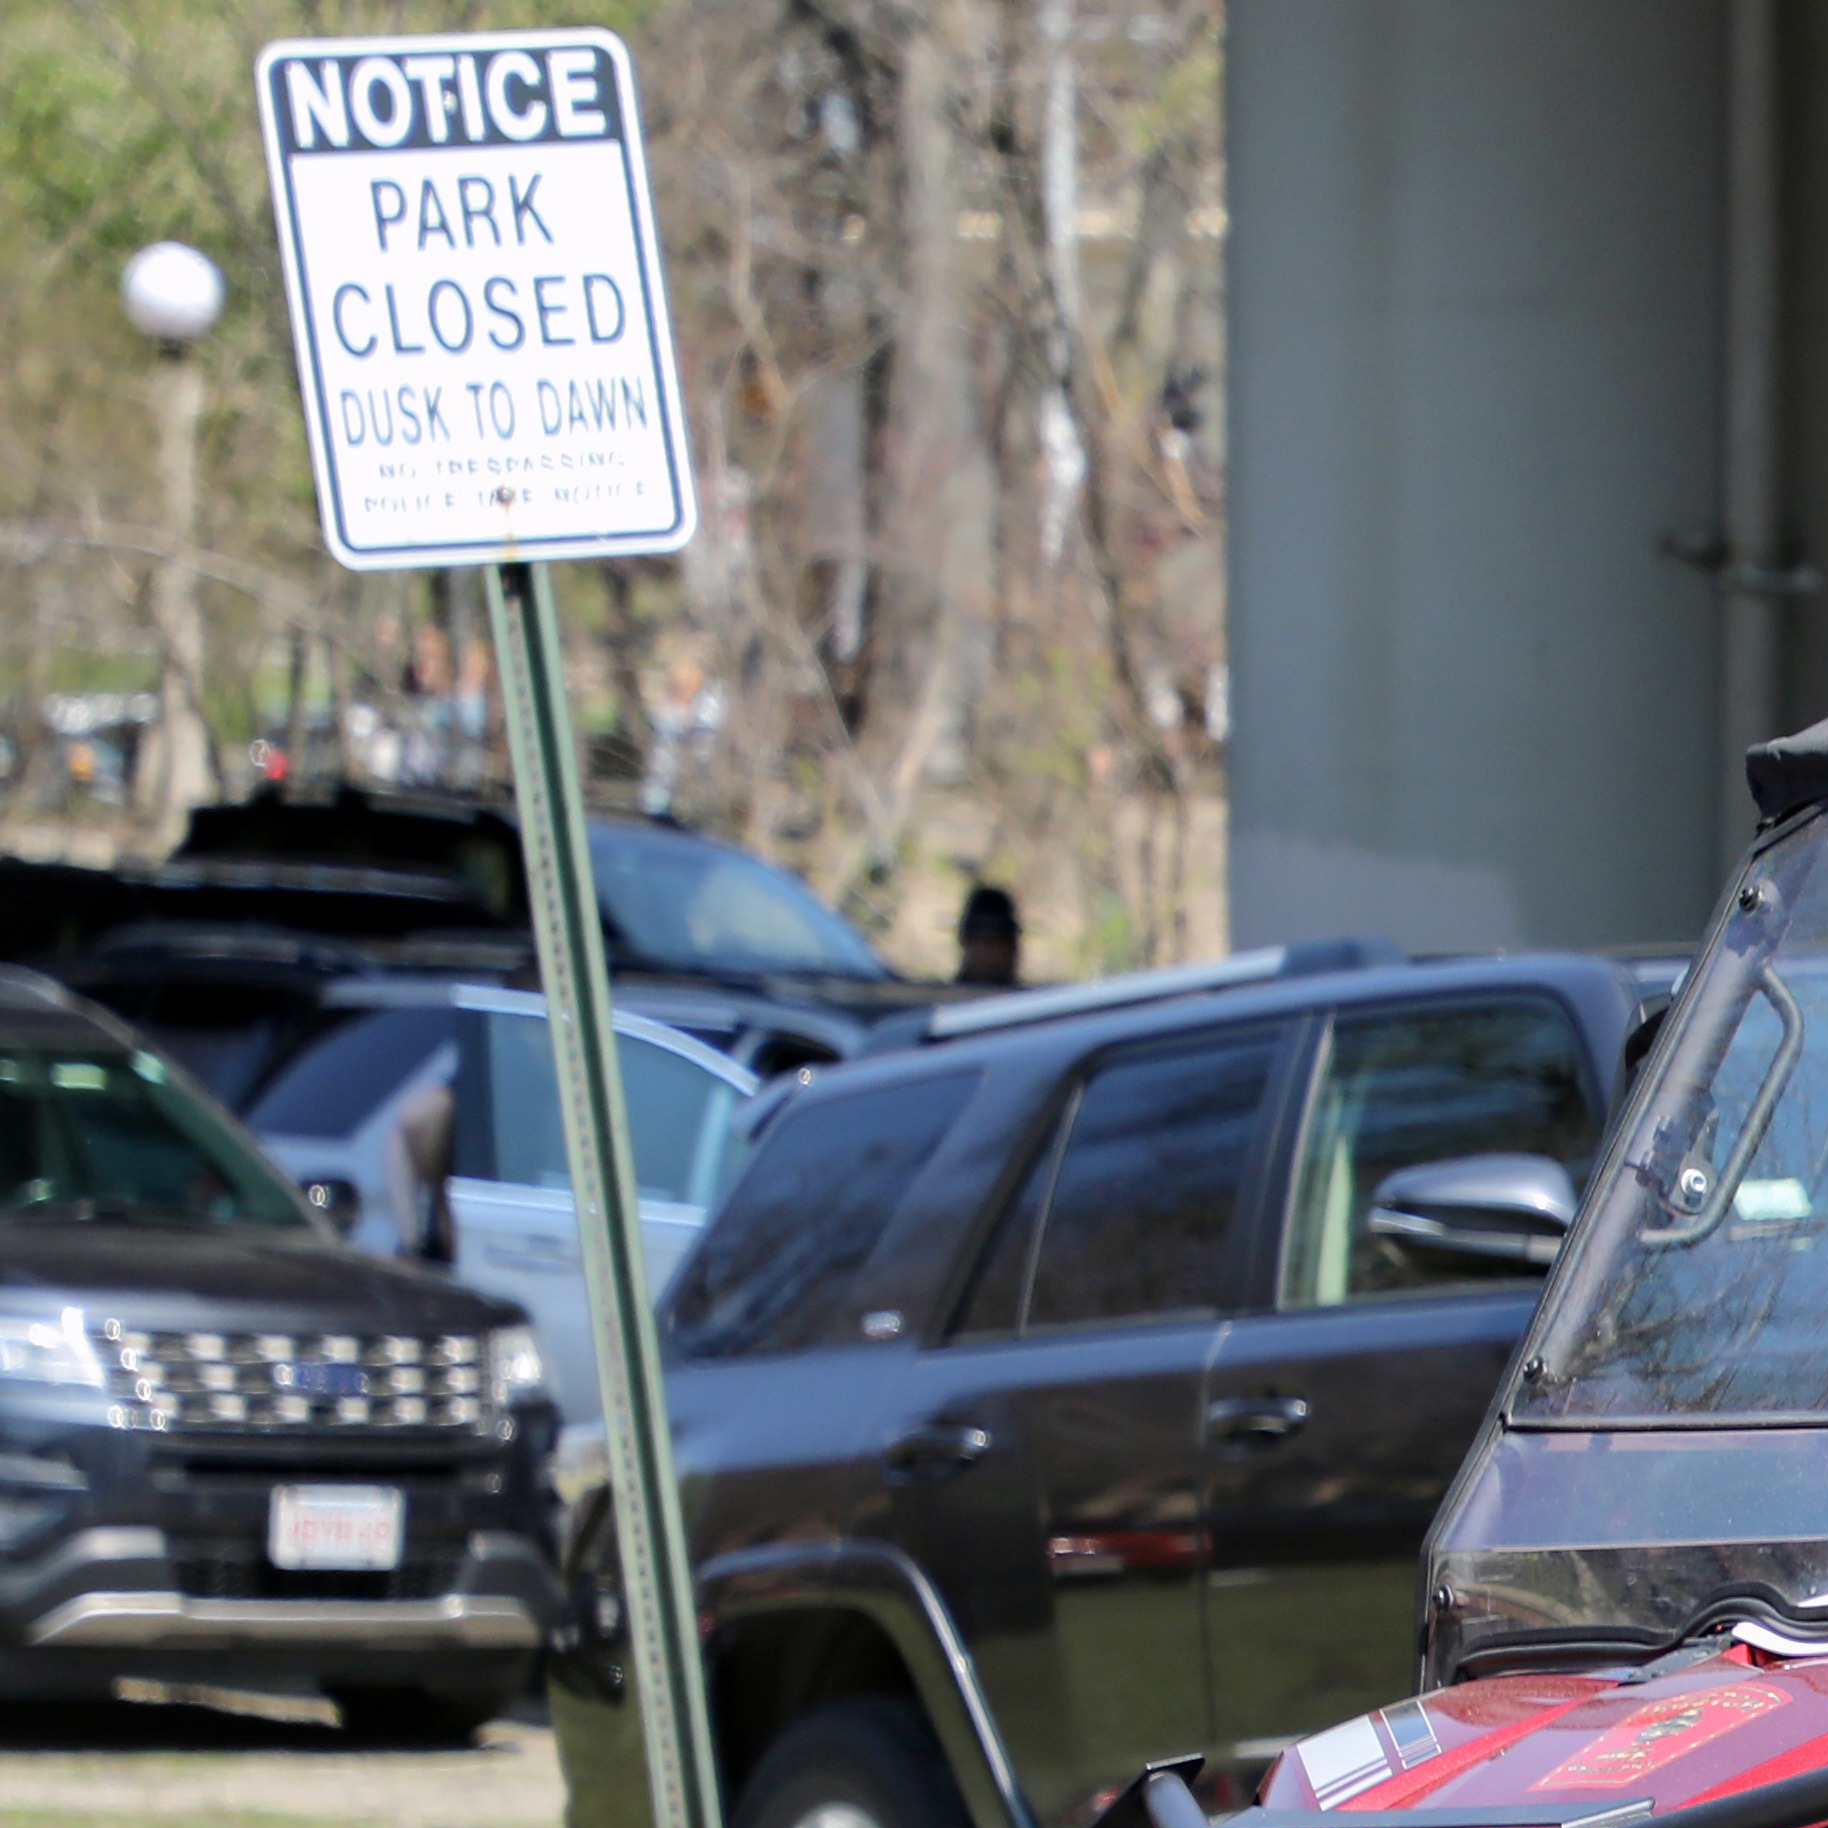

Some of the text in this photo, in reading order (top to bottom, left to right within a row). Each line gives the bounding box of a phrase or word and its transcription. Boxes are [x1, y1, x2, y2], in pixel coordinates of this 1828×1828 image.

[284, 49, 606, 149] NOTICE
[369, 172, 553, 252] PARK
[332, 273, 627, 359] CLOSED
[341, 376, 648, 447] DUSK TO DAWN
